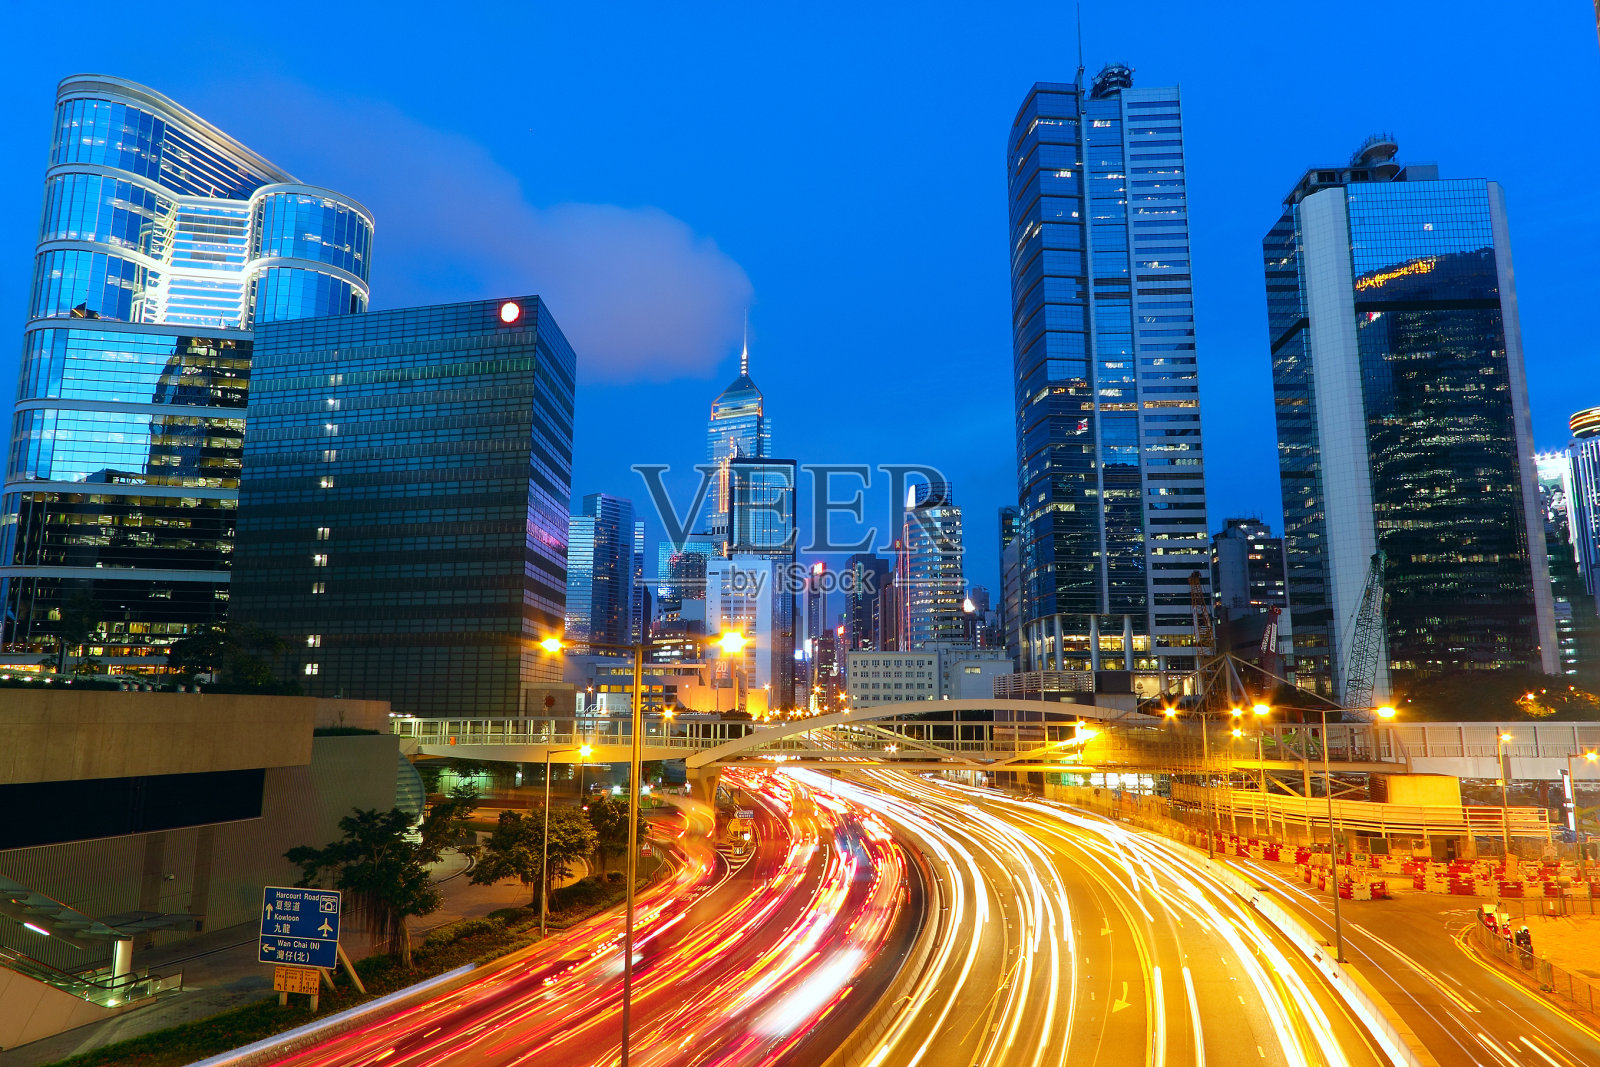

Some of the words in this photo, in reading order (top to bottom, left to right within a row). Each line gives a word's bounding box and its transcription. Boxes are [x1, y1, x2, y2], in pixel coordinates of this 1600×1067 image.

[715, 660, 727, 673] 20
[276, 891, 302, 899] Harcourt
[304, 892, 320, 901] Road
[274, 913, 300, 922] Kowloon
[274, 923, 290, 933] 九龍
[278, 939, 291, 947] Wan
[293, 940, 308, 949] Chai
[309, 941, 320, 951] (N)
